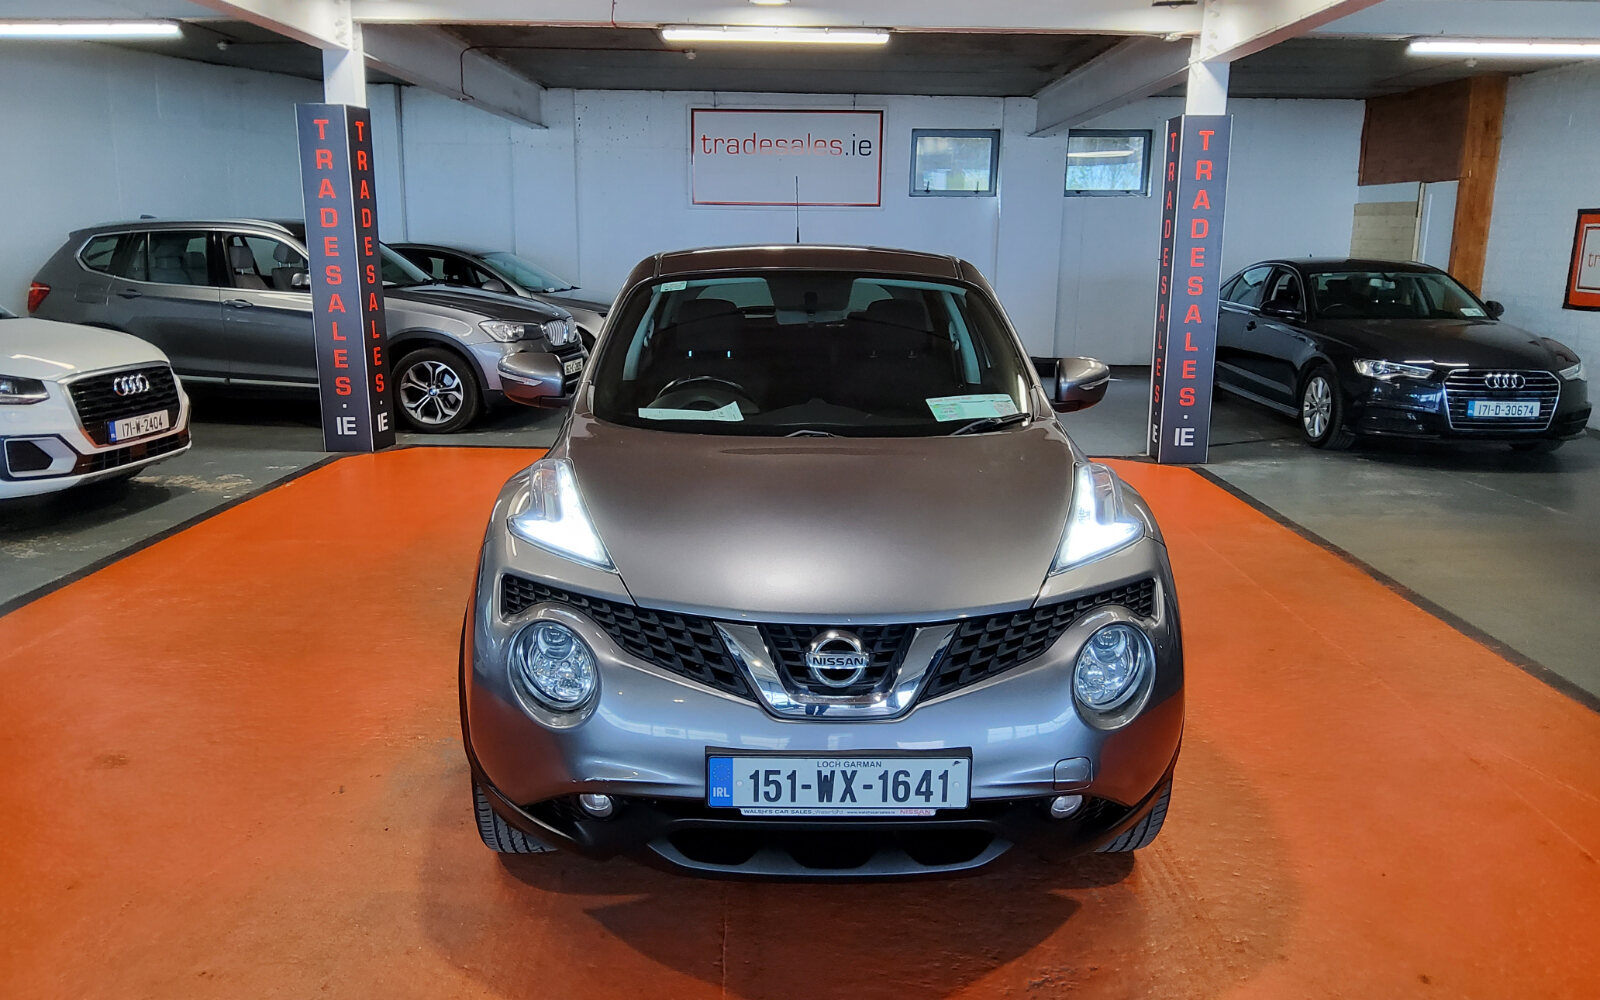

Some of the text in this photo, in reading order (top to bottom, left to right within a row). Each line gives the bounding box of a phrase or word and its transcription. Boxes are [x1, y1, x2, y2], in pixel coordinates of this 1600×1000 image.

[701, 132, 872, 157] tradesales.ie
[1478, 404, 1534, 416] 171-D-30674
[121, 414, 163, 437] 171-W-2404
[812, 657, 864, 666] NISSAN
[816, 760, 882, 768] LOCH GARMAN
[749, 769, 949, 803] 151-WX-1641
[712, 787, 731, 798] IRL
